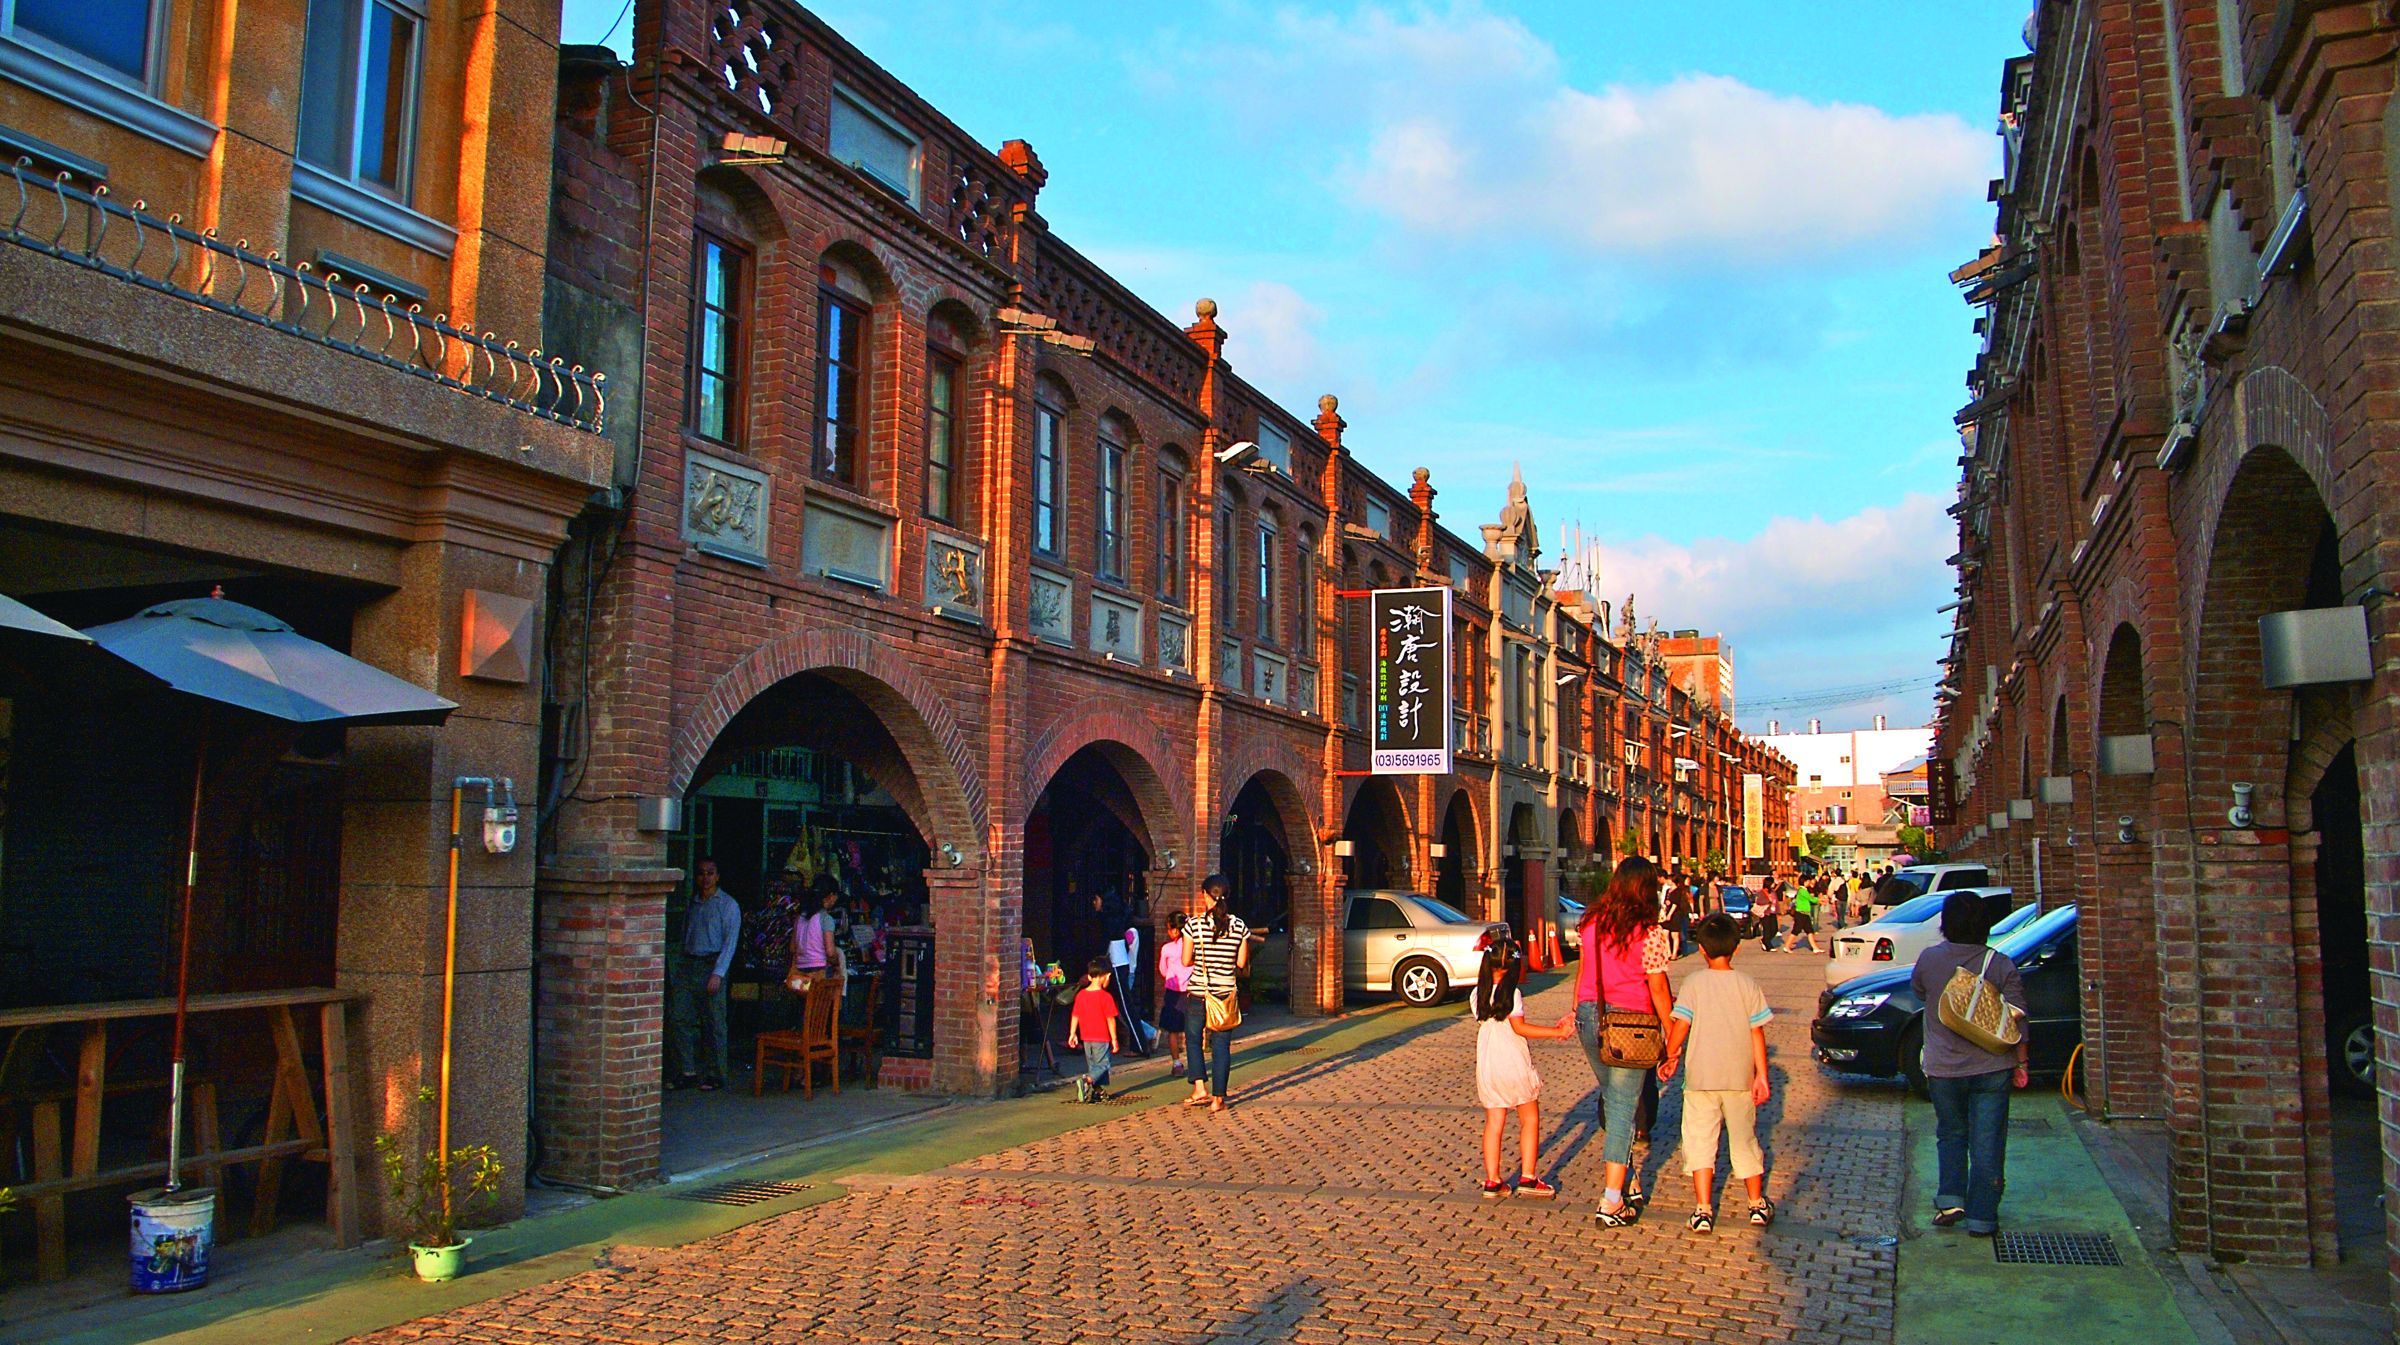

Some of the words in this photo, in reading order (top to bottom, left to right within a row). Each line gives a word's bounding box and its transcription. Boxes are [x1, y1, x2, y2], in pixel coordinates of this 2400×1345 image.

[1389, 605, 1441, 740] 瀚唐設計
[1375, 754, 1441, 767] (03)5691965
